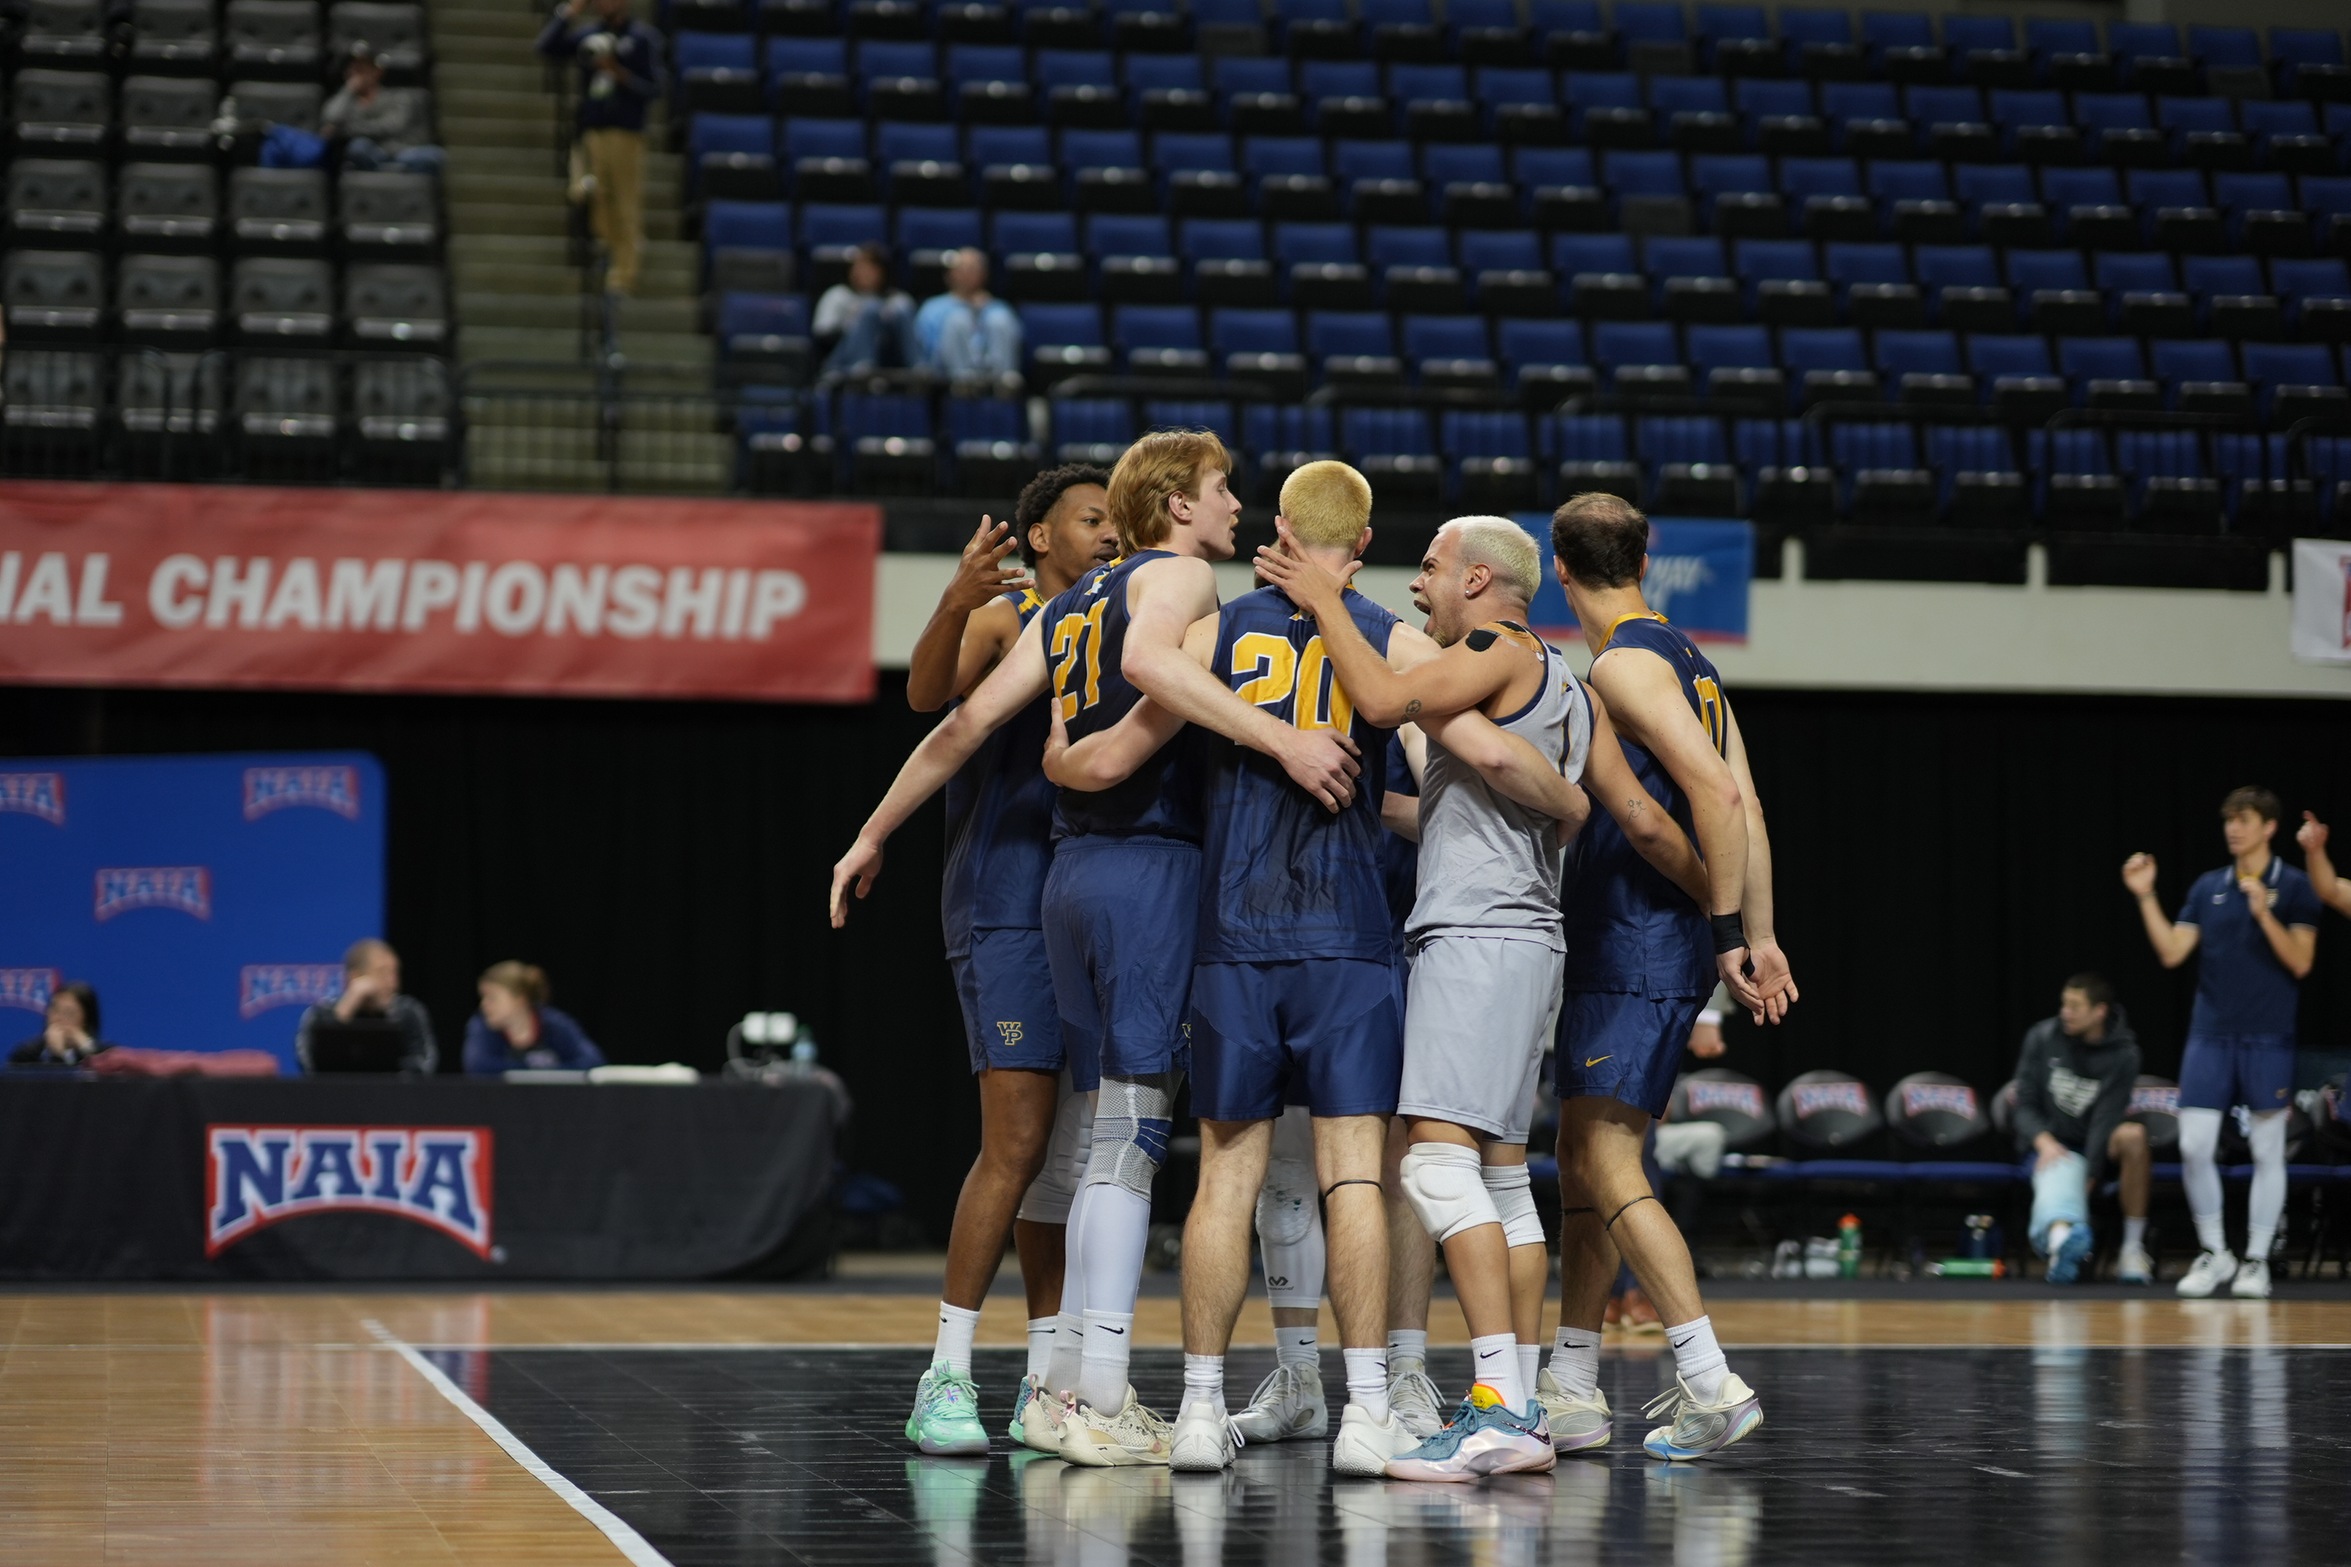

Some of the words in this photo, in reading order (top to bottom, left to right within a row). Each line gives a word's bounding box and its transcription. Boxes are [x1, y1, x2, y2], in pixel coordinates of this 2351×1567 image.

[148, 552, 806, 640] CHAMPIONSHIP
[1050, 597, 1108, 722] 21
[1231, 632, 1355, 740] 20
[209, 1128, 487, 1245] NAIA
